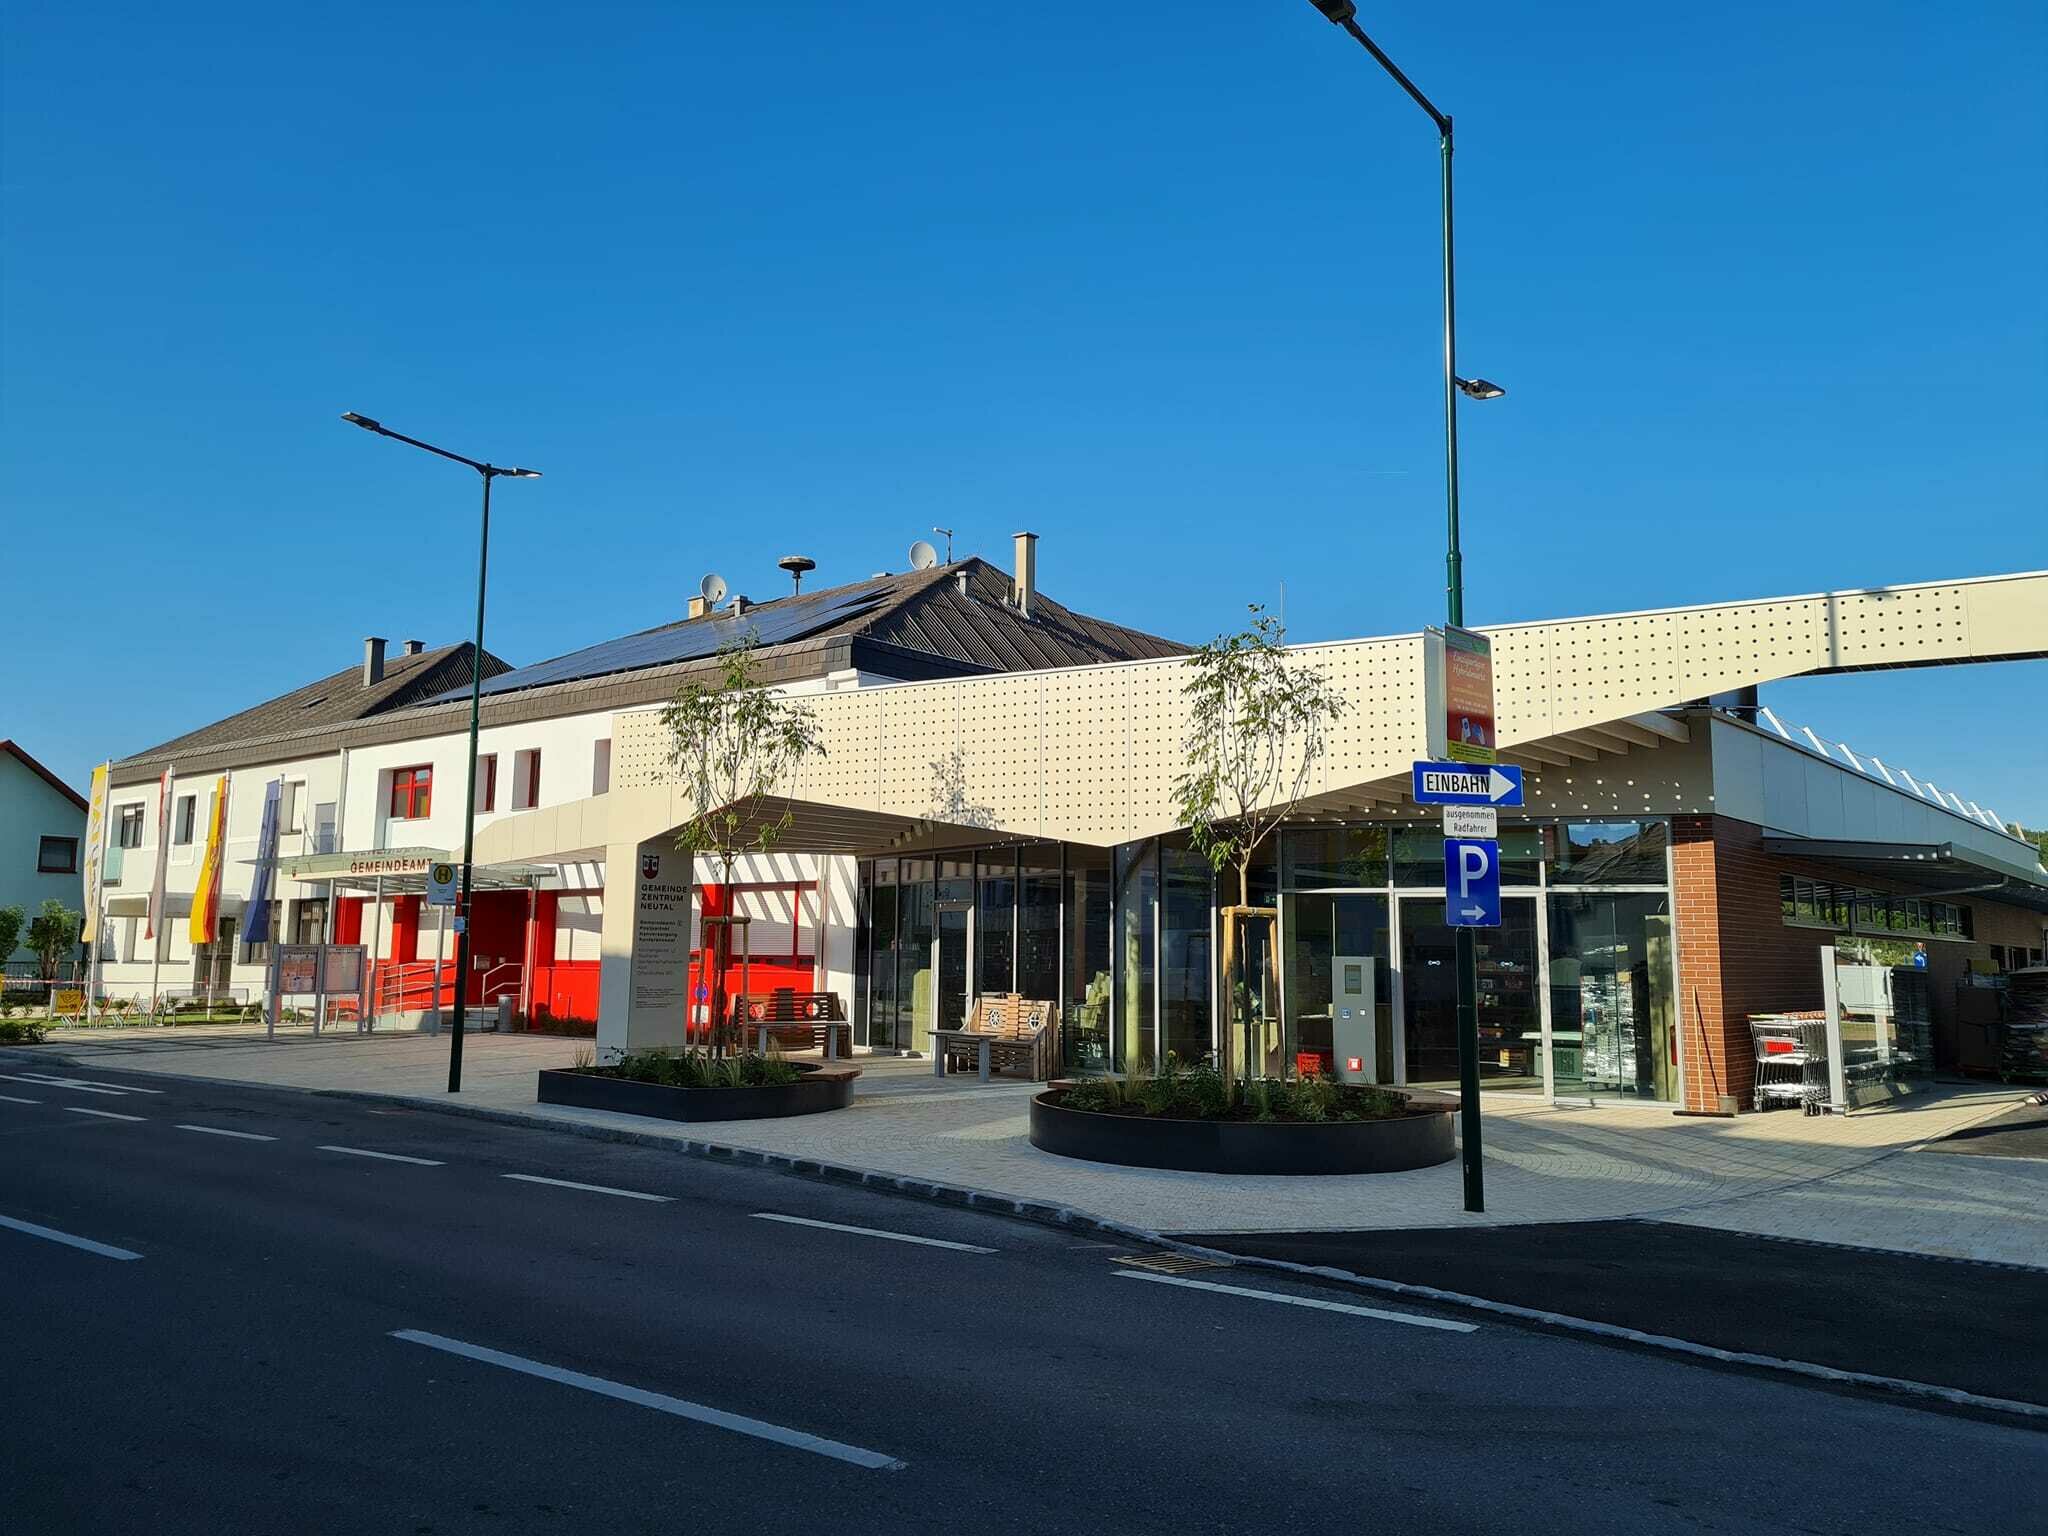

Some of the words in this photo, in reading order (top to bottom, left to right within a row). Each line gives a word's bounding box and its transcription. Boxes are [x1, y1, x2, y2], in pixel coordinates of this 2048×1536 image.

[1426, 774, 1489, 793] EINBAHN
[1446, 810, 1495, 820] ausgenommen
[1454, 823, 1488, 833] Radfahrer
[350, 858, 432, 873] GEMEINDEAMT
[1459, 845, 1489, 898] P
[641, 884, 687, 893] GEMEINDE
[641, 894, 684, 902] ZENTRUM
[640, 903, 674, 911] NEUTAL
